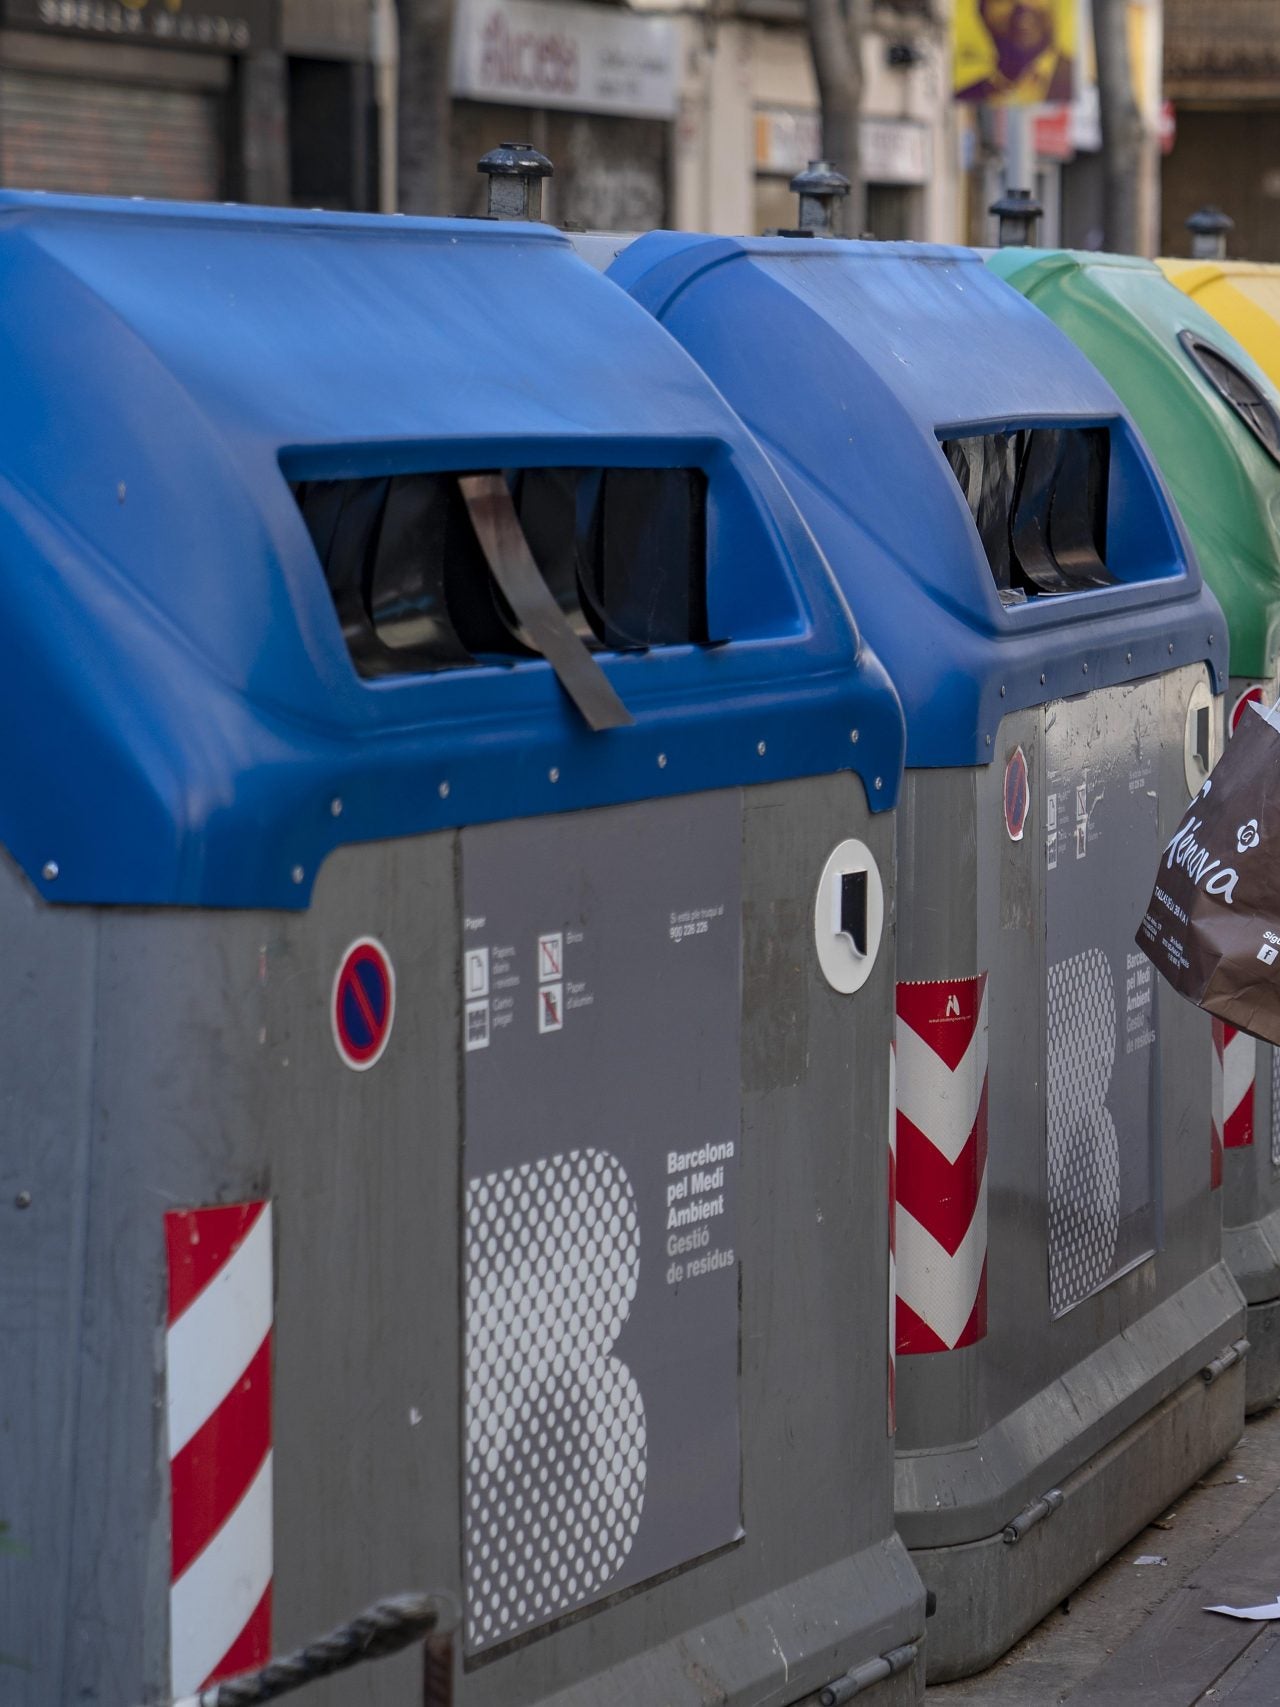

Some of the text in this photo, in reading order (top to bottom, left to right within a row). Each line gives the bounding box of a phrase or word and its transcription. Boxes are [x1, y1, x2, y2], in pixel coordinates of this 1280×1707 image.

[1127, 987, 1151, 1012] Ambient
[667, 1141, 734, 1175] Barcelona
[667, 1166, 724, 1207] pel Medi
[667, 1194, 724, 1230] Ambient
[667, 1225, 710, 1257] Gestió
[667, 1248, 735, 1285] de residus
